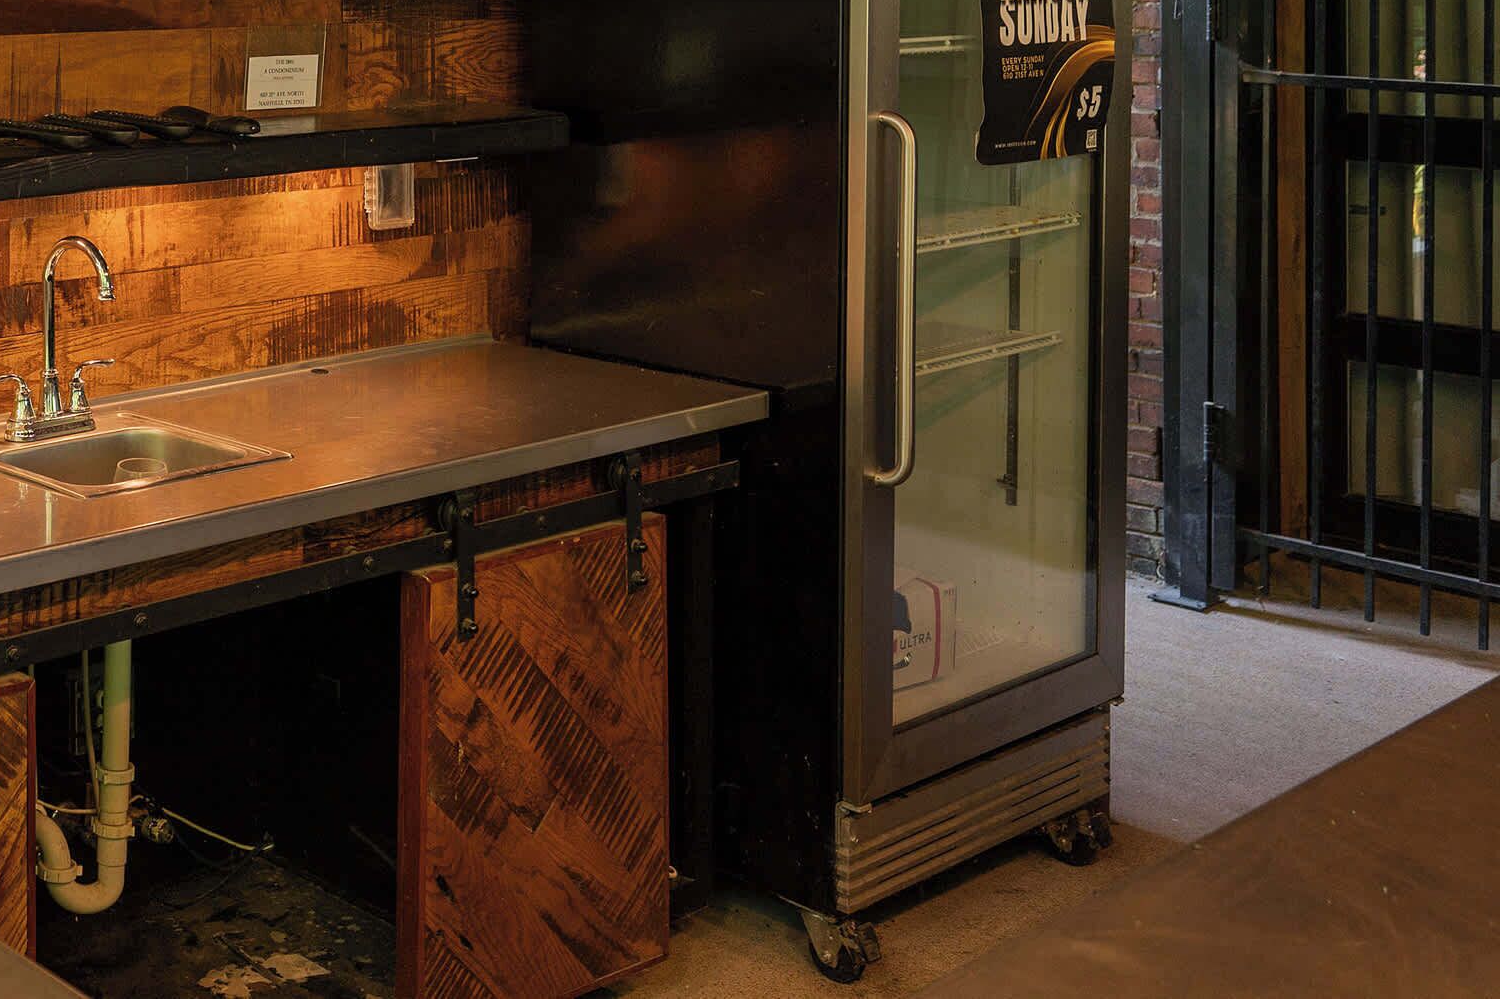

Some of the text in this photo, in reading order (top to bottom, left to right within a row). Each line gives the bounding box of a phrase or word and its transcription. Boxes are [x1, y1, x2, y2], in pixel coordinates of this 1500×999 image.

[1001, 55, 1044, 65] EVERY SUNDAY
[1002, 64, 1019, 72] OPEN
[1077, 85, 1102, 120] $5
[900, 631, 932, 650] ULTRA
